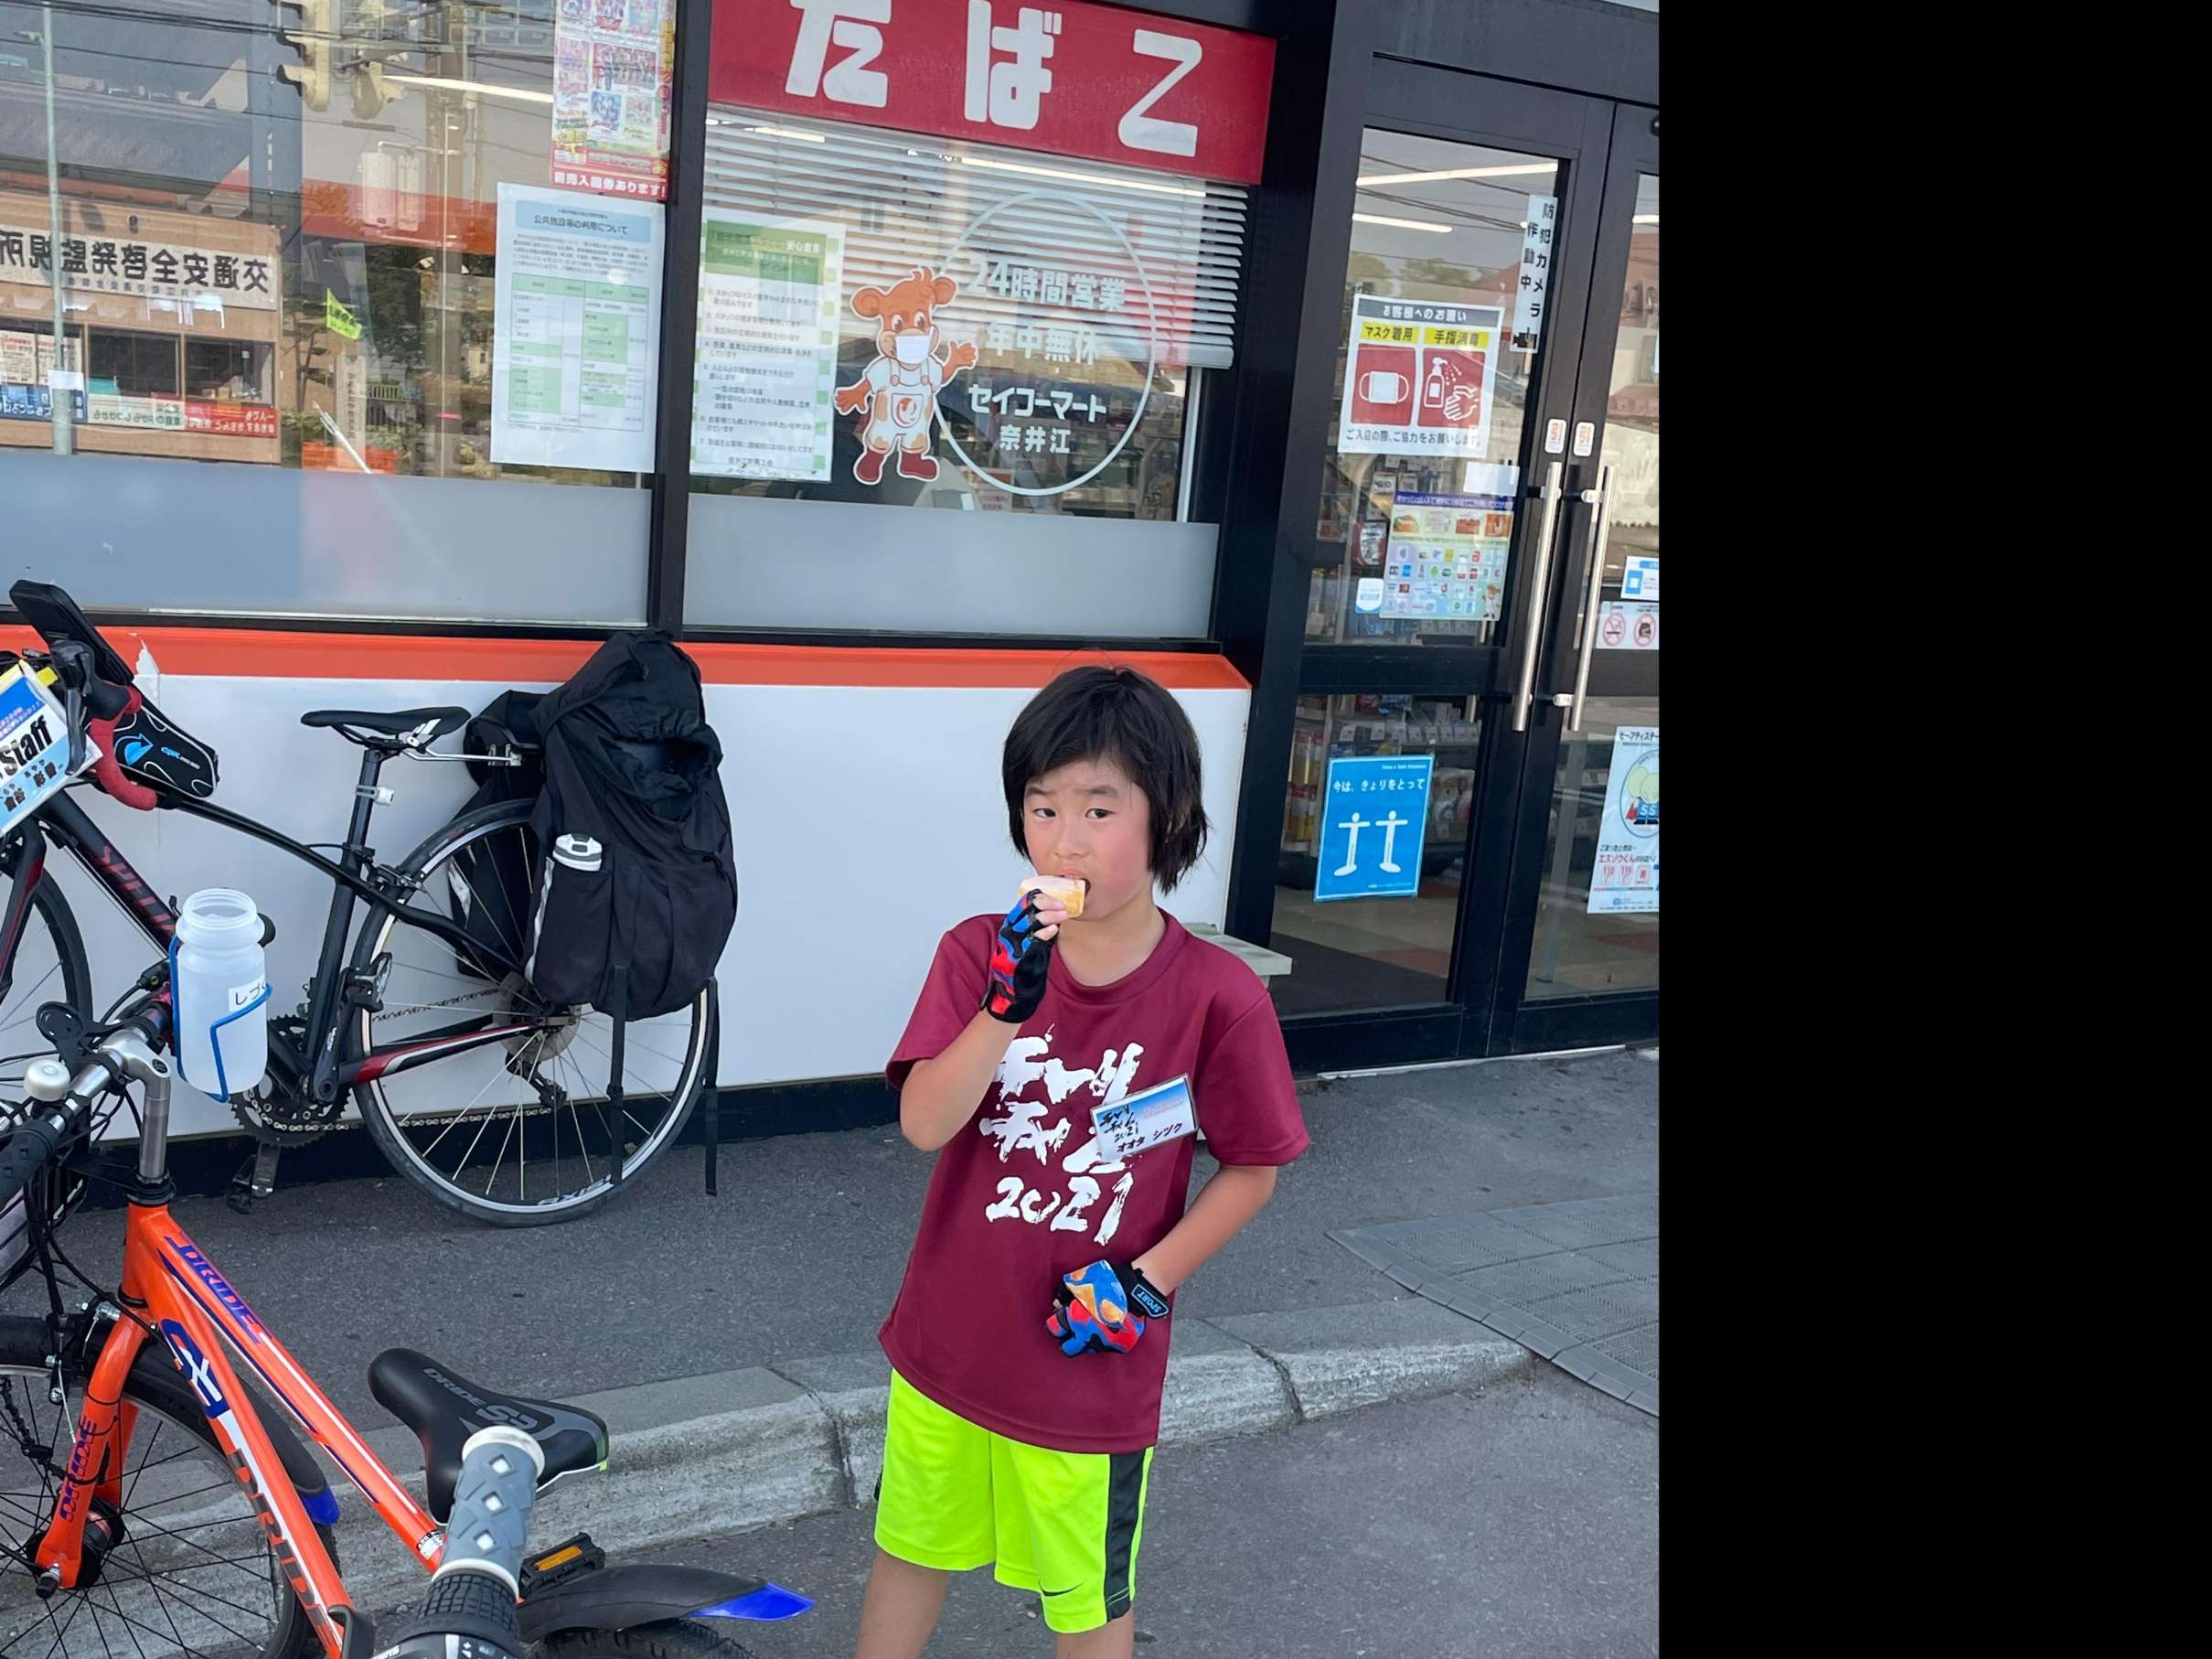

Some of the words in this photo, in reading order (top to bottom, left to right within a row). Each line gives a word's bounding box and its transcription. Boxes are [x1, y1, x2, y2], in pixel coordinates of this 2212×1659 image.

[784, 0, 1203, 157] たばこ
[967, 259, 1127, 312] 24時間営業
[1383, 305, 1467, 322] お客様へのお願い
[986, 320, 1098, 365] 年中無休
[968, 384, 1107, 423] セイコーマート
[999, 424, 1071, 454] 奈井江
[0, 714, 53, 776] Staff
[986, 1172, 1134, 1247] 2021
[1136, 1291, 1162, 1313] SPORT
